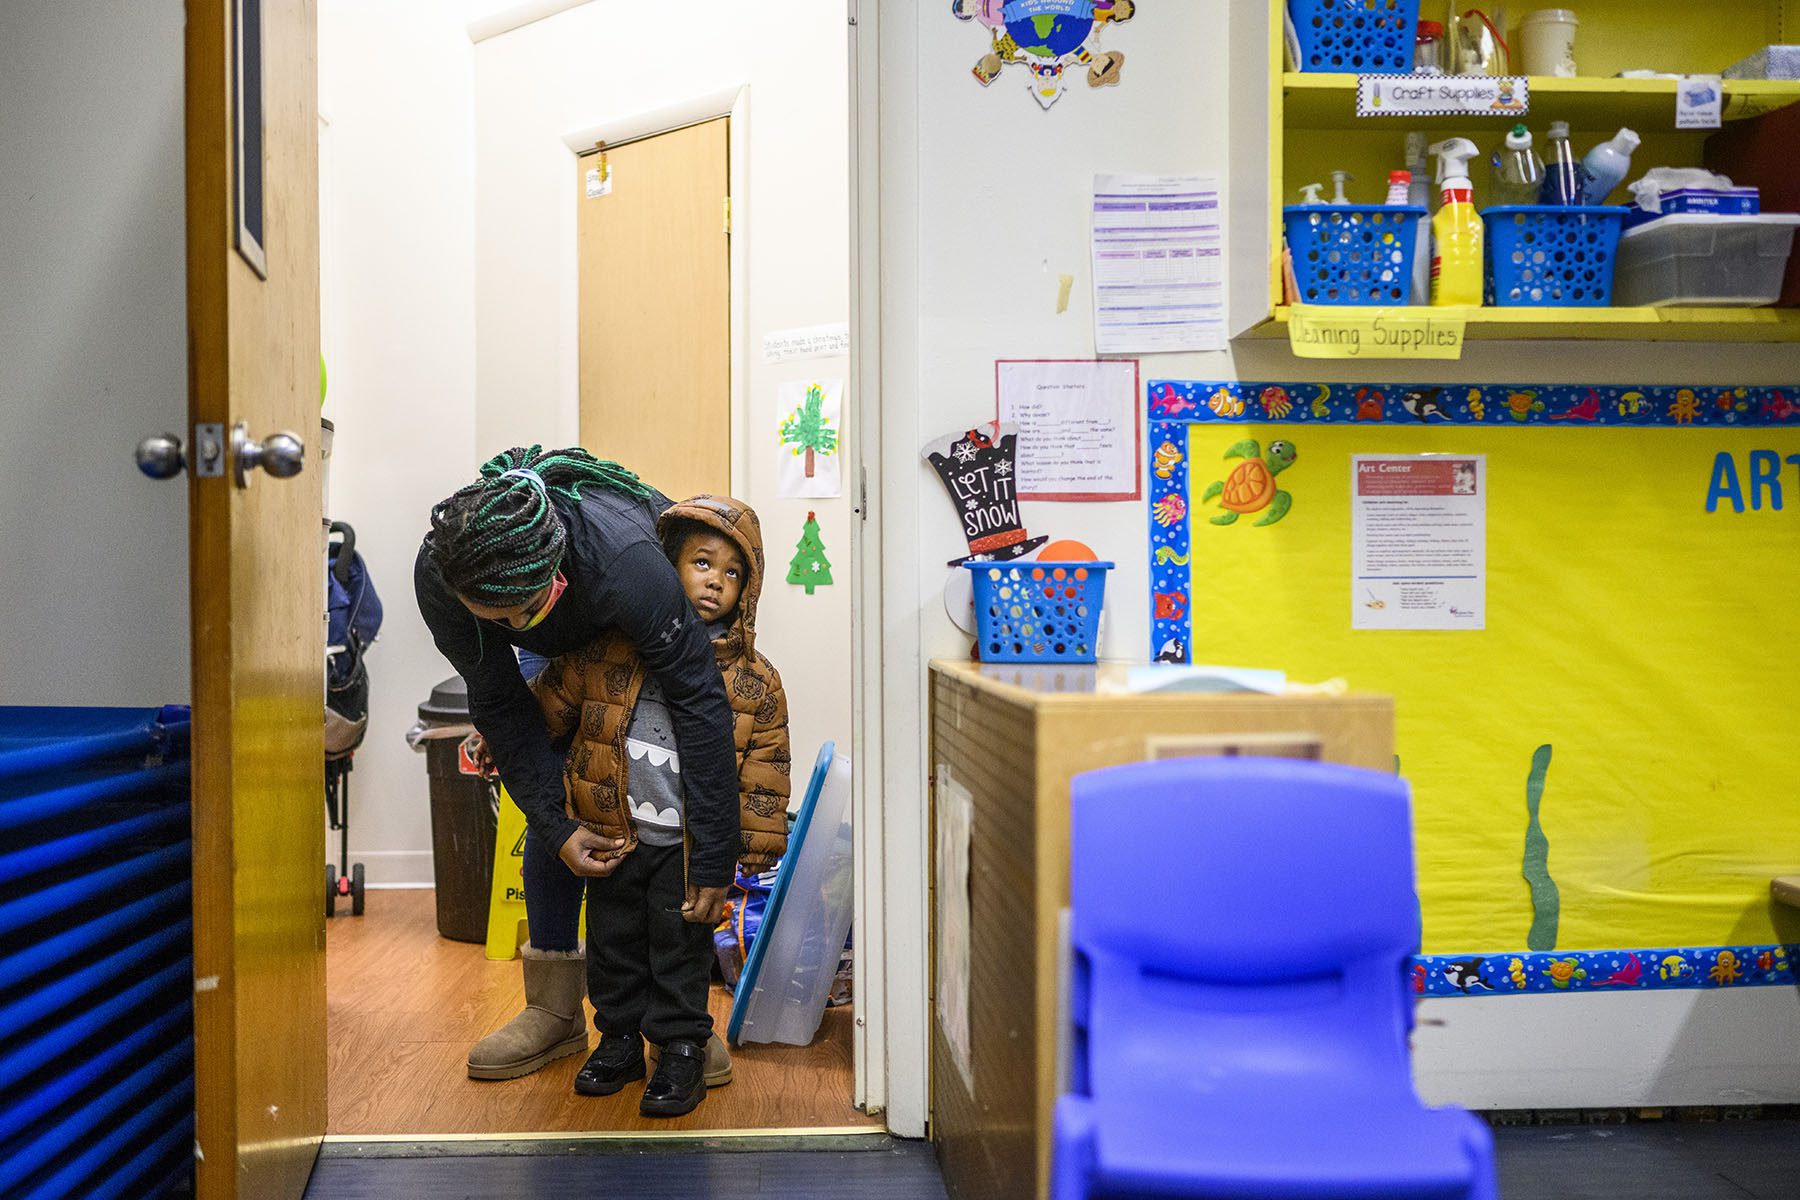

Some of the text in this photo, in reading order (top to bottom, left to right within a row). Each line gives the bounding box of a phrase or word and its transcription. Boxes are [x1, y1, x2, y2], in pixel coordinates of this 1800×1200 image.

[1392, 86, 1495, 102] Craft Supplies
[1372, 317, 1458, 352] Supplies
[1358, 463, 1413, 473] Art Center
[993, 477, 1012, 501] IT
